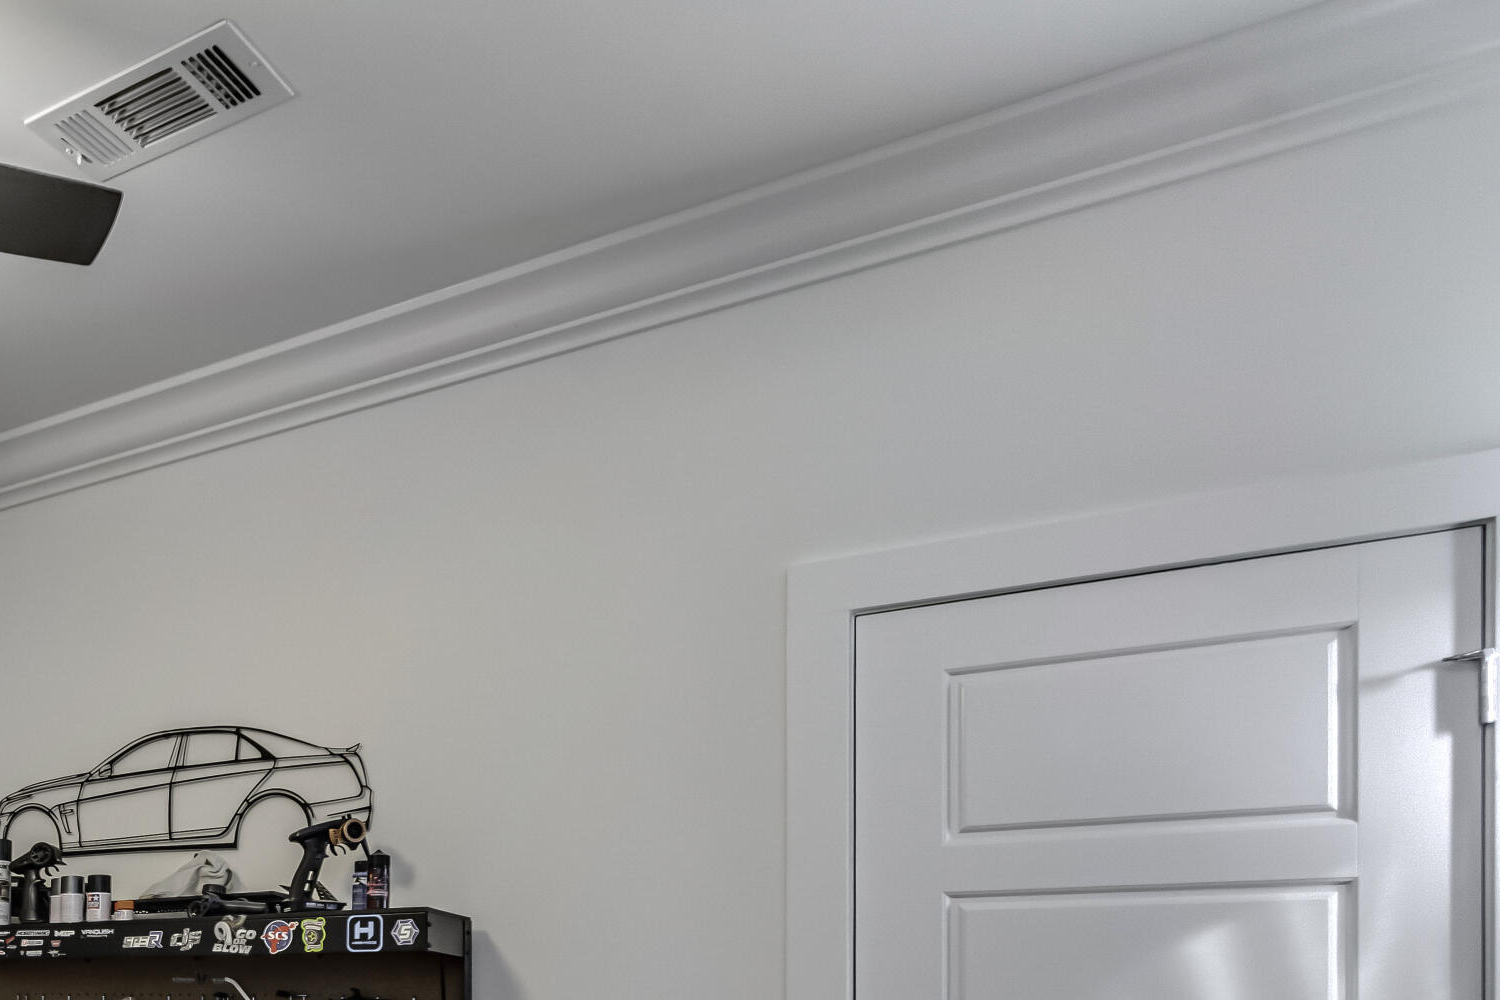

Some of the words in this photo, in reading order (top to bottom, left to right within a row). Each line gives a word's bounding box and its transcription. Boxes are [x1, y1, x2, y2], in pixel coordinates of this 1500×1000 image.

[236, 929, 257, 940] GO
[268, 930, 288, 940] SCS
[212, 943, 252, 954] BLOW
